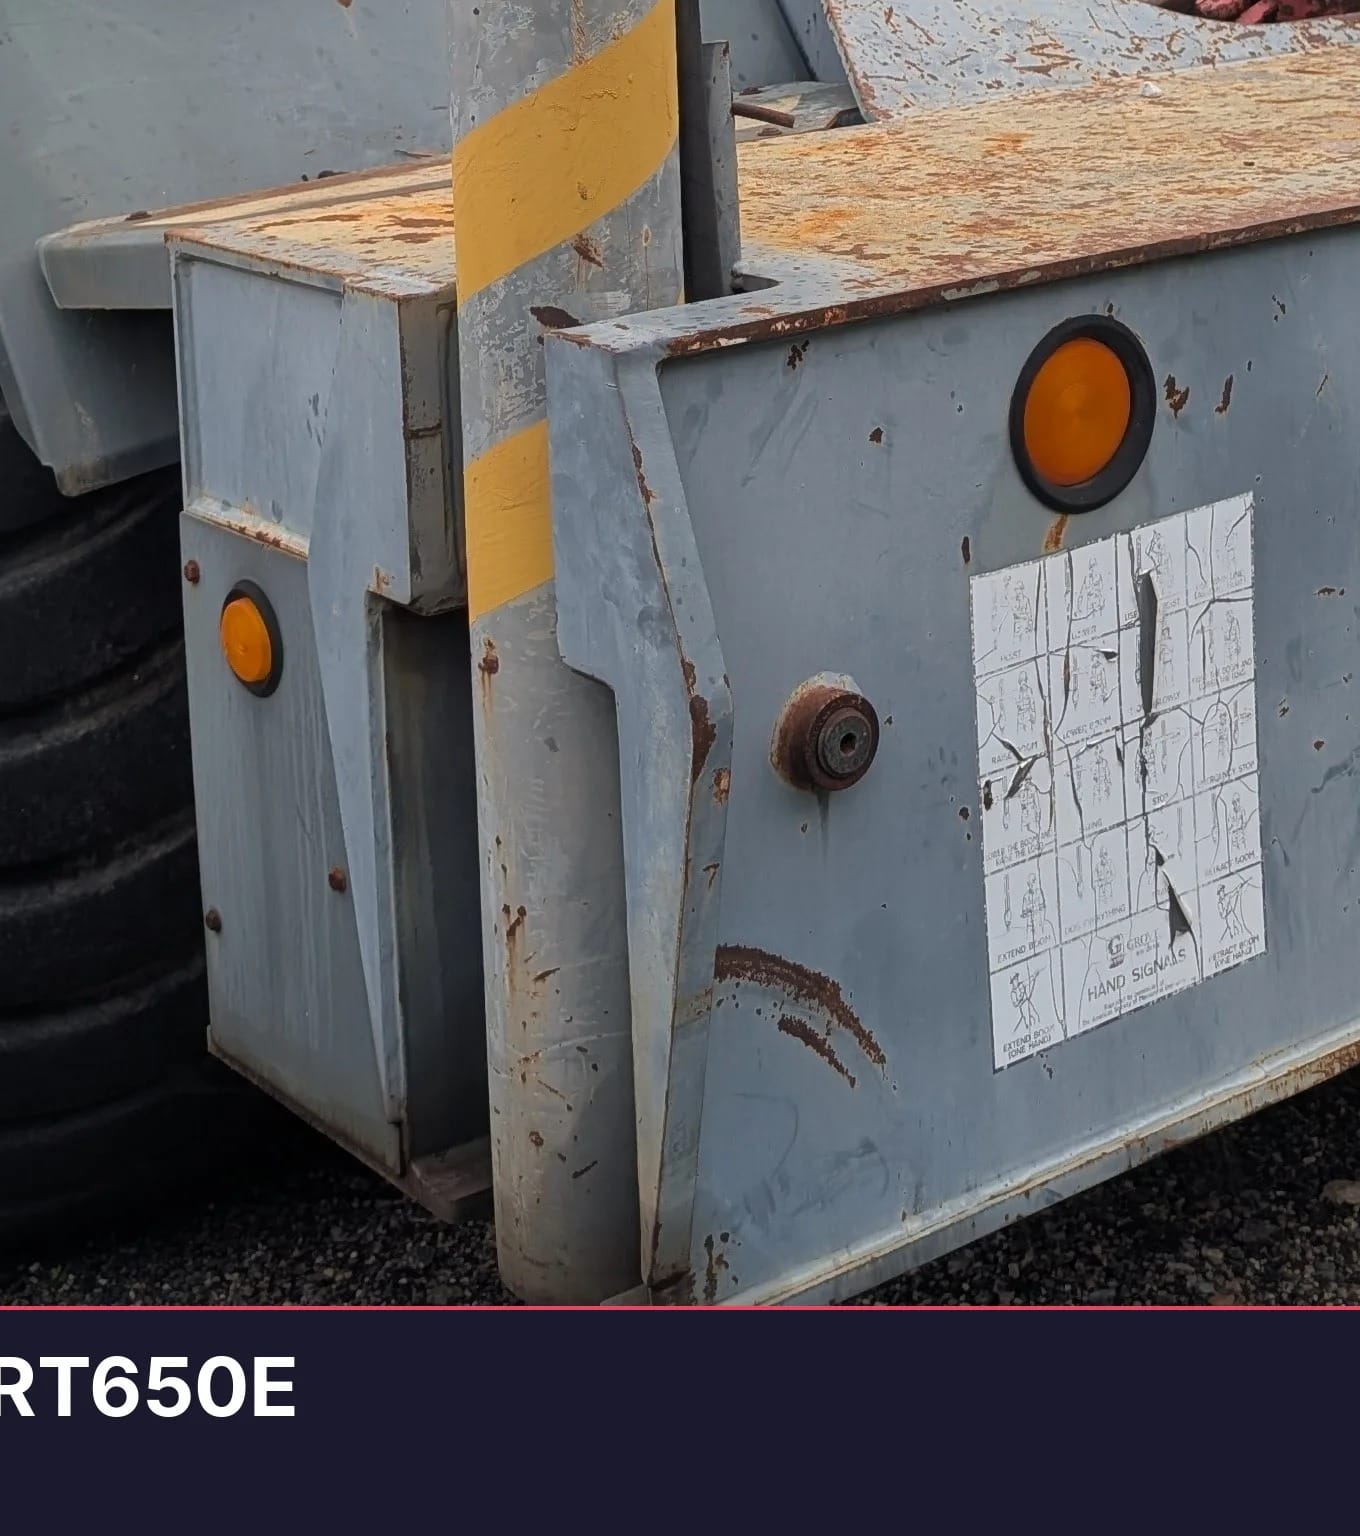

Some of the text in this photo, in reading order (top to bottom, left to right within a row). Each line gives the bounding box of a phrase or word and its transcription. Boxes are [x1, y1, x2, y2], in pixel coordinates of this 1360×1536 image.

[997, 944, 1027, 964] EXTEND
[1087, 973, 1126, 1003] HAND
[1132, 948, 1187, 983] SIGNALS
[1003, 1033, 1032, 1053] EXTEND
